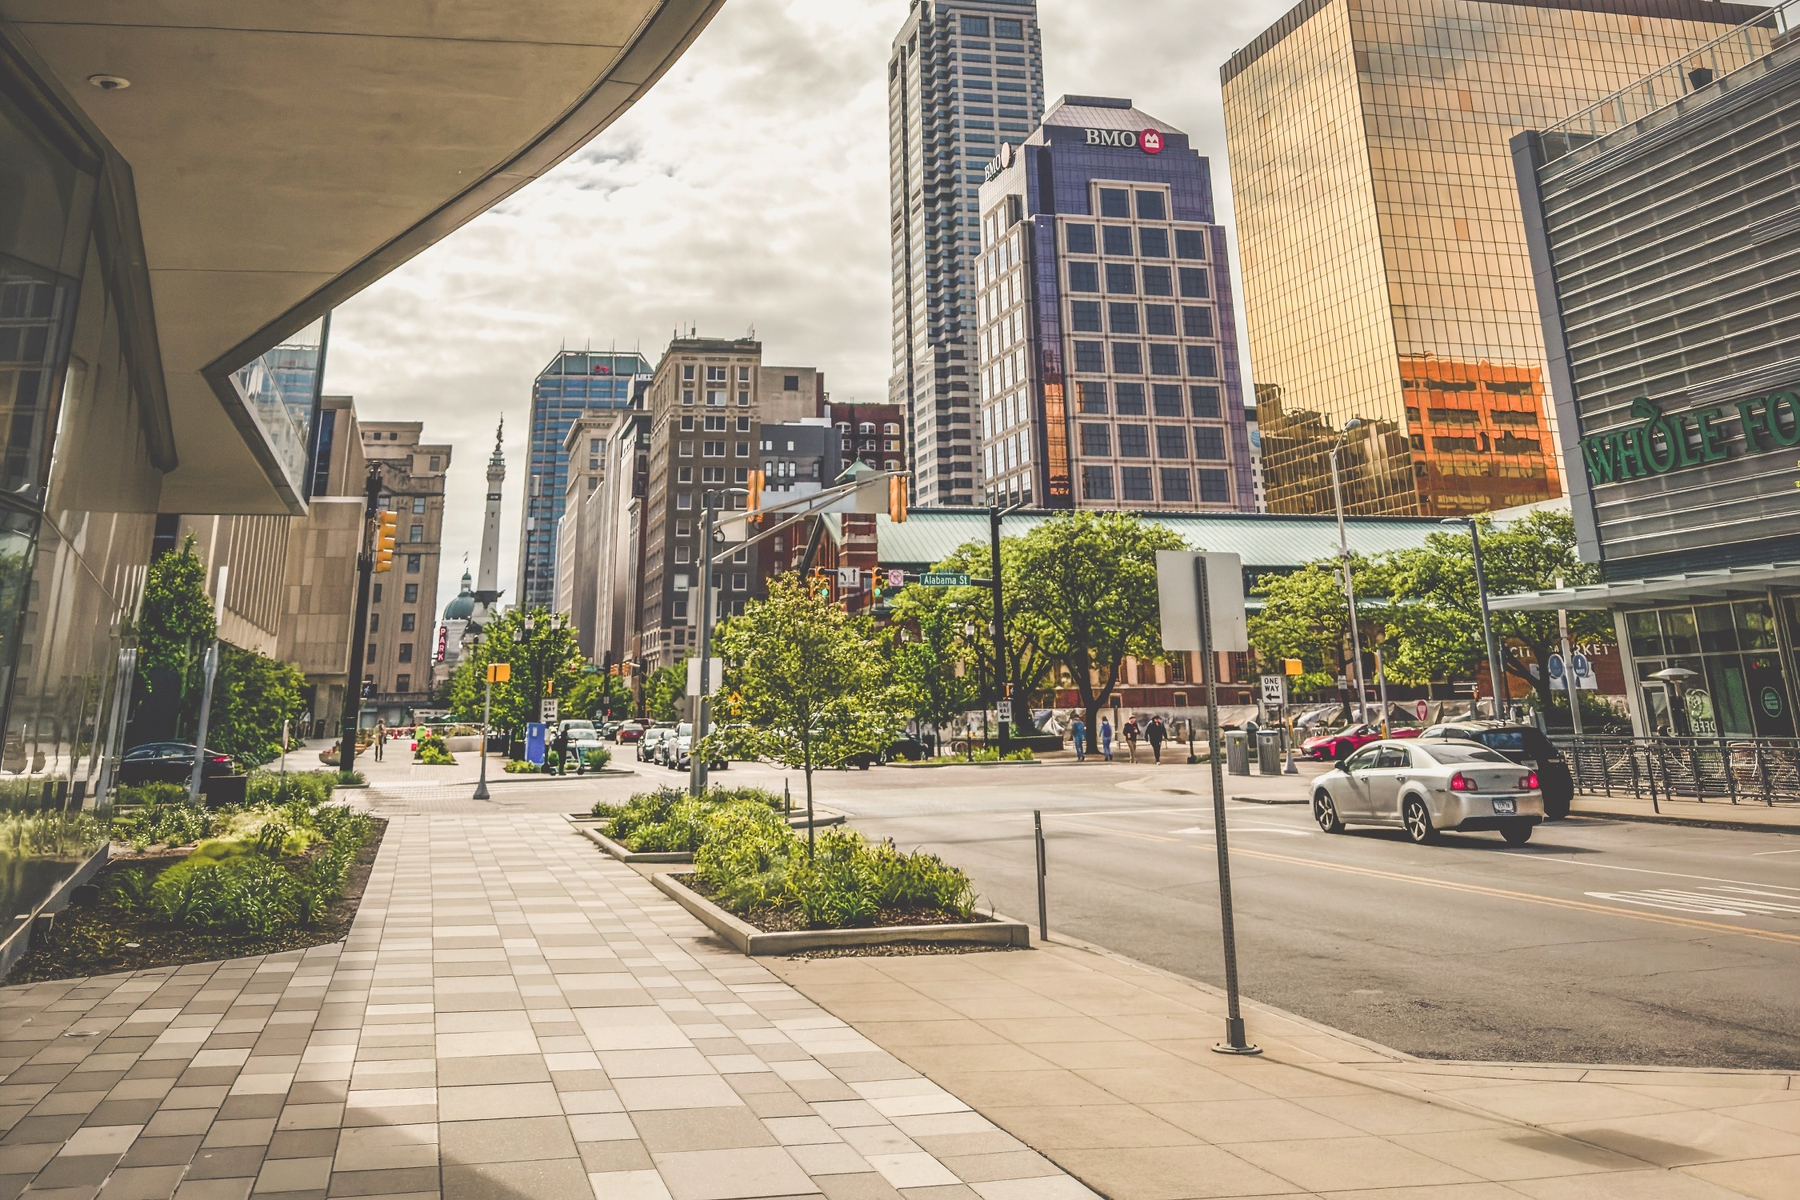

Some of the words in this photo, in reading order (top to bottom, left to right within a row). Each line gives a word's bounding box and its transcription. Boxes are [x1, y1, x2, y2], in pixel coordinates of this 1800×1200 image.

[1085, 129, 1136, 147] BMO
[1578, 397, 1730, 485] WHOLE
[924, 576, 957, 585] Alabama
[959, 576, 968, 585] St
[438, 627, 446, 661] PARK
[1549, 643, 1610, 656] MRKET
[1264, 677, 1279, 685] ONE
